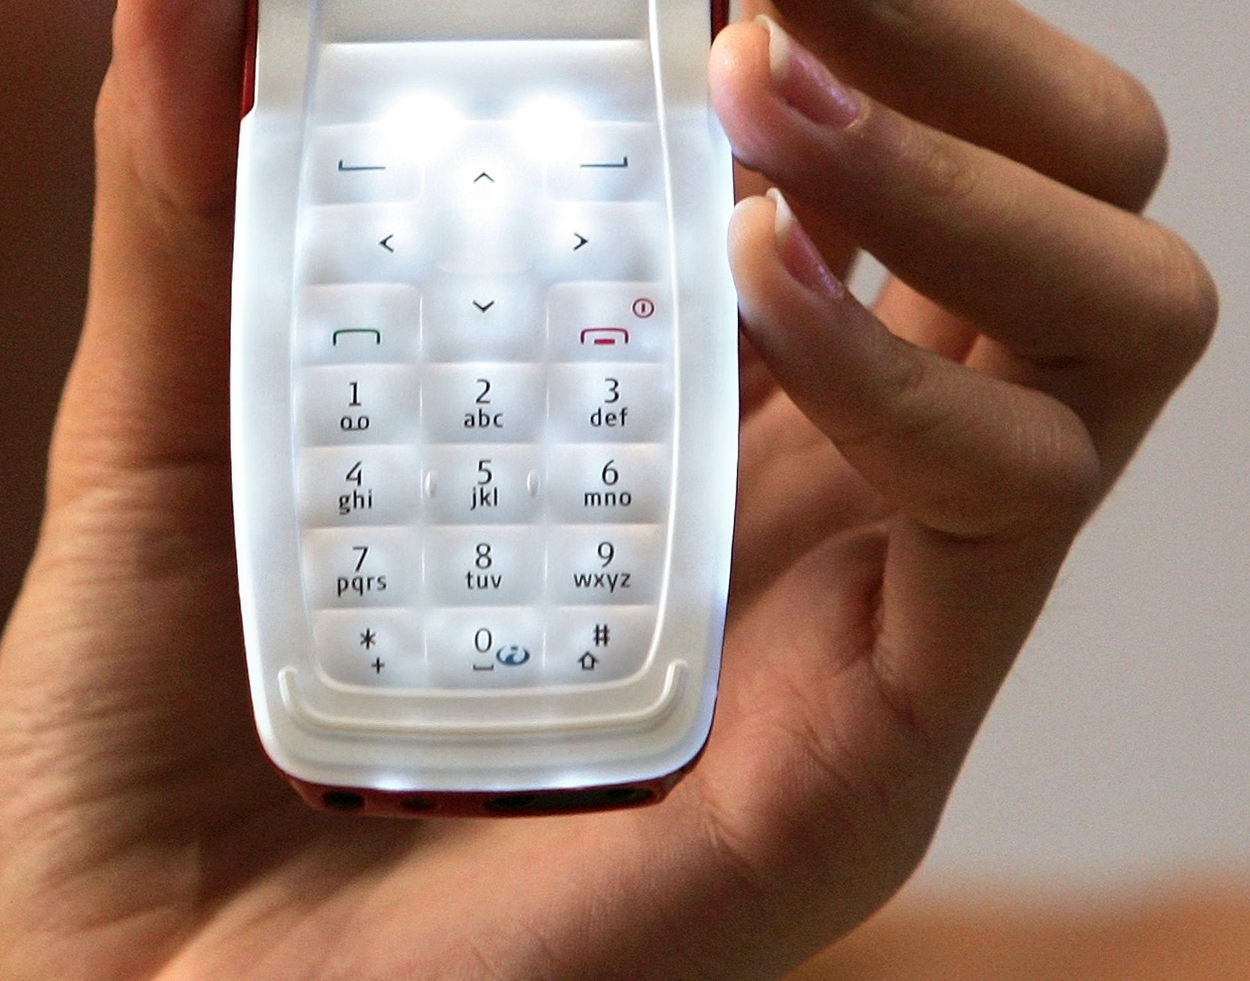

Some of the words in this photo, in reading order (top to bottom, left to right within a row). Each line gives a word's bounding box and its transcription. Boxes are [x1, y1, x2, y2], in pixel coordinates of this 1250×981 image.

[349, 381, 361, 407] 1
[476, 379, 490, 404] 2
[605, 378, 619, 403] 3
[464, 408, 503, 429] abc
[590, 407, 628, 428] def
[345, 461, 362, 487] 4
[478, 459, 492, 485] 5
[602, 459, 619, 486] 6
[338, 490, 373, 515] ghi
[470, 486, 497, 511] jkl
[584, 492, 632, 508] mno
[353, 546, 368, 572] 7
[476, 543, 492, 569] 8
[598, 542, 614, 568] 9
[336, 576, 387, 597] pqrs
[465, 571, 502, 590] tuv
[574, 573, 631, 594] wxyz
[475, 628, 492, 653] 0
[593, 624, 610, 647] #
